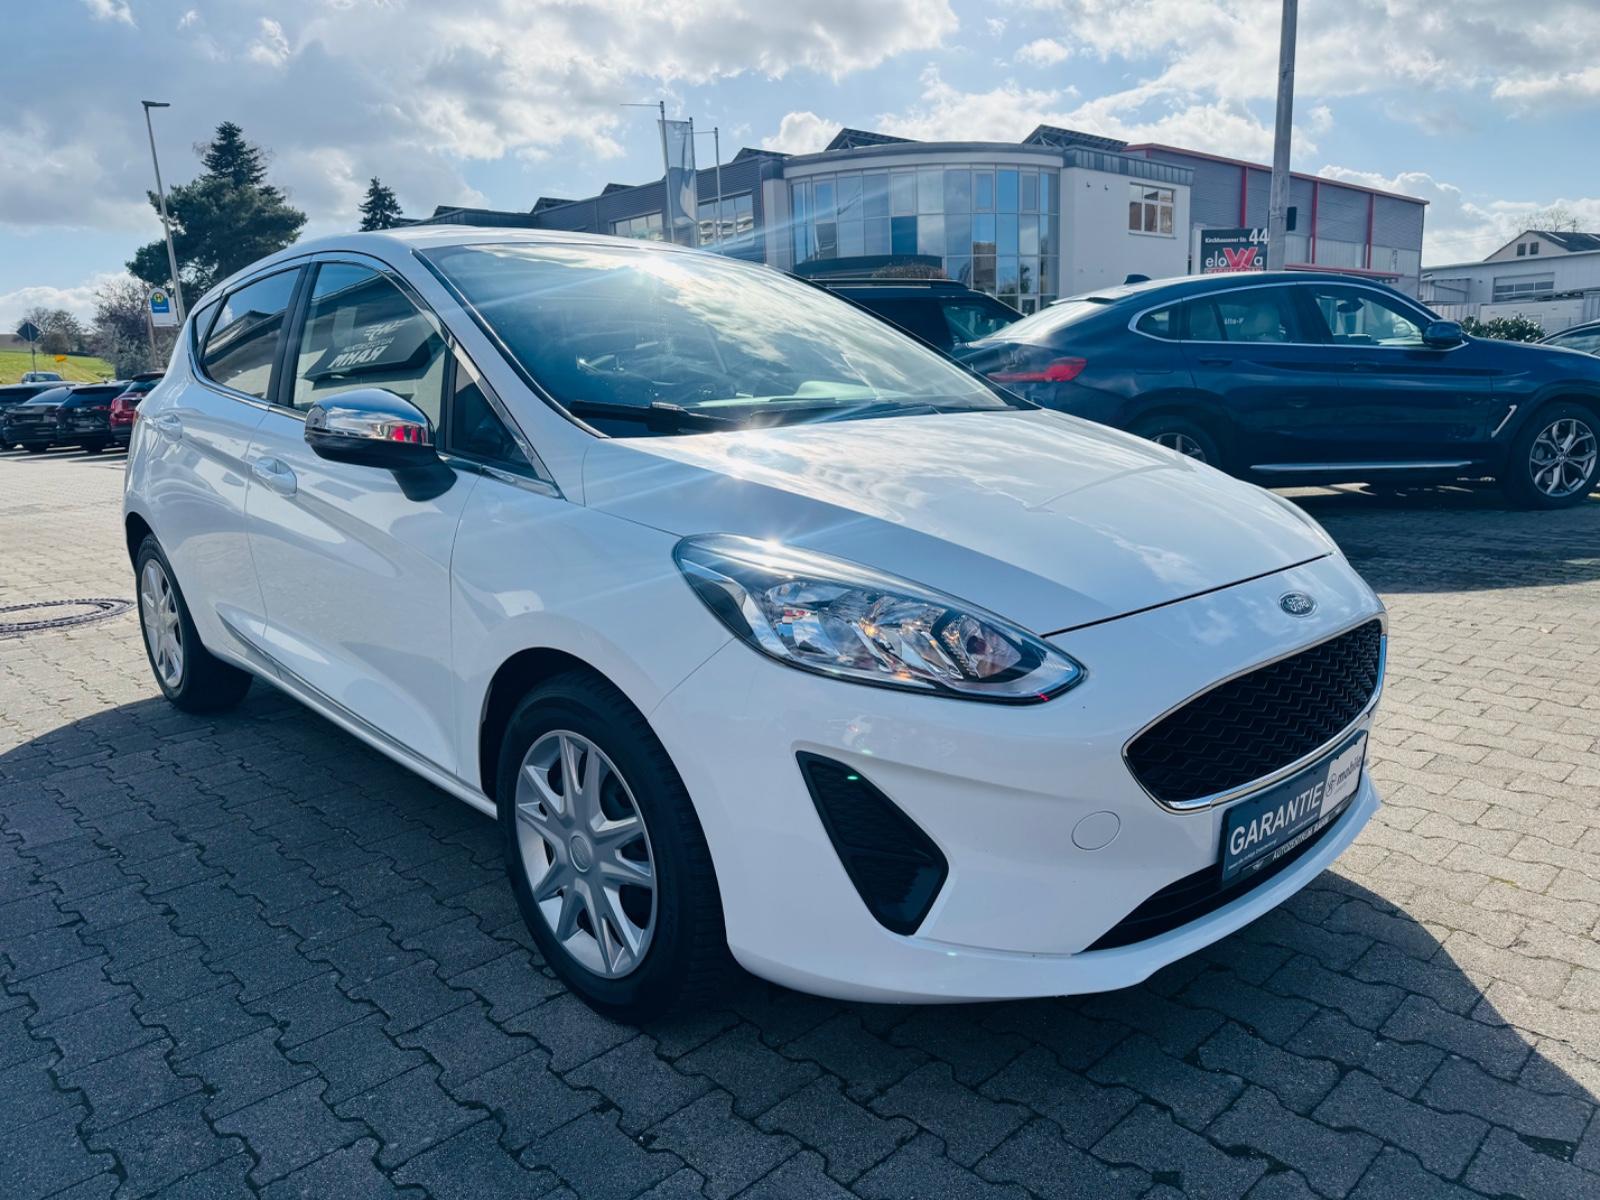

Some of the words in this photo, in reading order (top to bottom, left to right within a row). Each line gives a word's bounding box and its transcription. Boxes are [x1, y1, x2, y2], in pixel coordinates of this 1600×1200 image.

[1249, 228, 1270, 245] 44
[1286, 596, 1310, 612] Ford
[1229, 780, 1325, 856] GARANTIE
